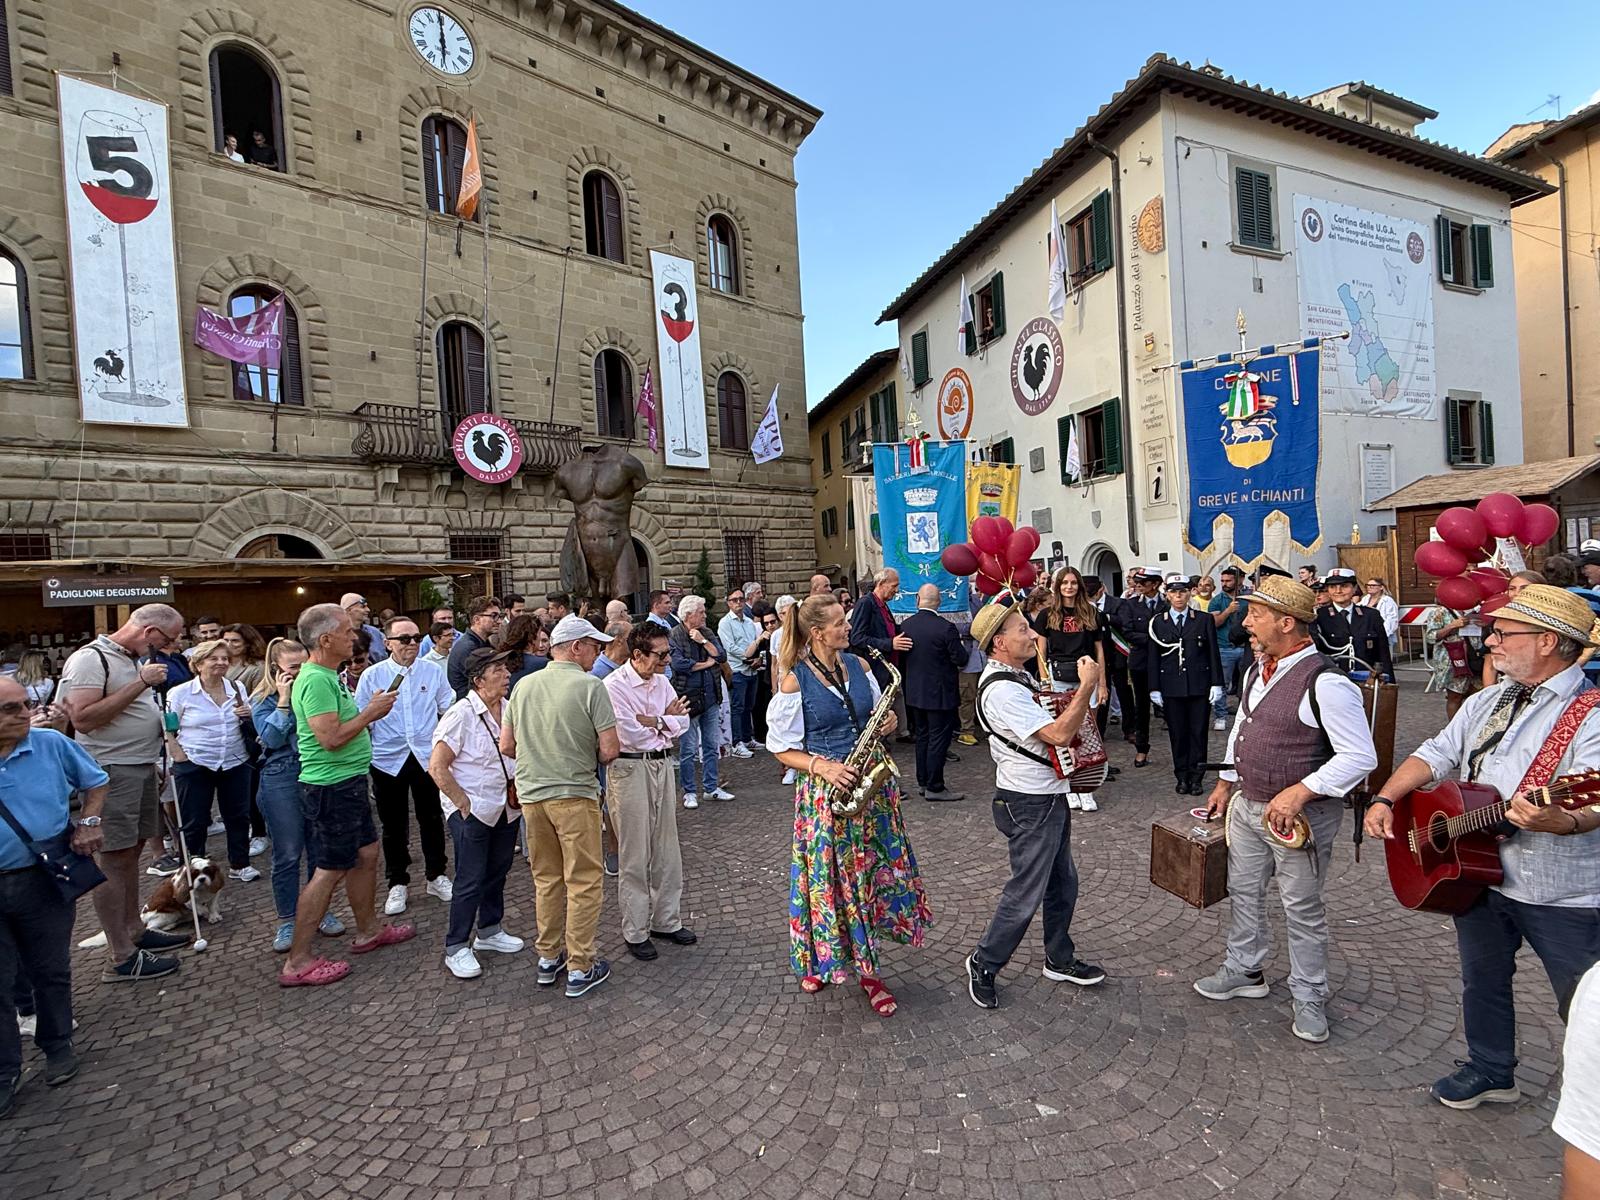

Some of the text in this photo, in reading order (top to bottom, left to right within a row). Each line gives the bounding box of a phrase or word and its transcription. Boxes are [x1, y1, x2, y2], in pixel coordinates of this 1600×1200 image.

[86, 136, 154, 199] 5
[1334, 214, 1357, 227] Cartina
[1376, 224, 1397, 236] U.G.A.
[1130, 214, 1142, 331] Palazzo del Fiorino
[661, 282, 688, 322] 3
[1012, 321, 1062, 388] CHIANTI CLASSICO
[456, 416, 520, 460] CHIANTI CLASSICO
[1198, 492, 1238, 507] GREVE
[1251, 488, 1304, 502] CHIANTI
[50, 588, 168, 598] PADIGLIONE DEGUSTAZIONI
